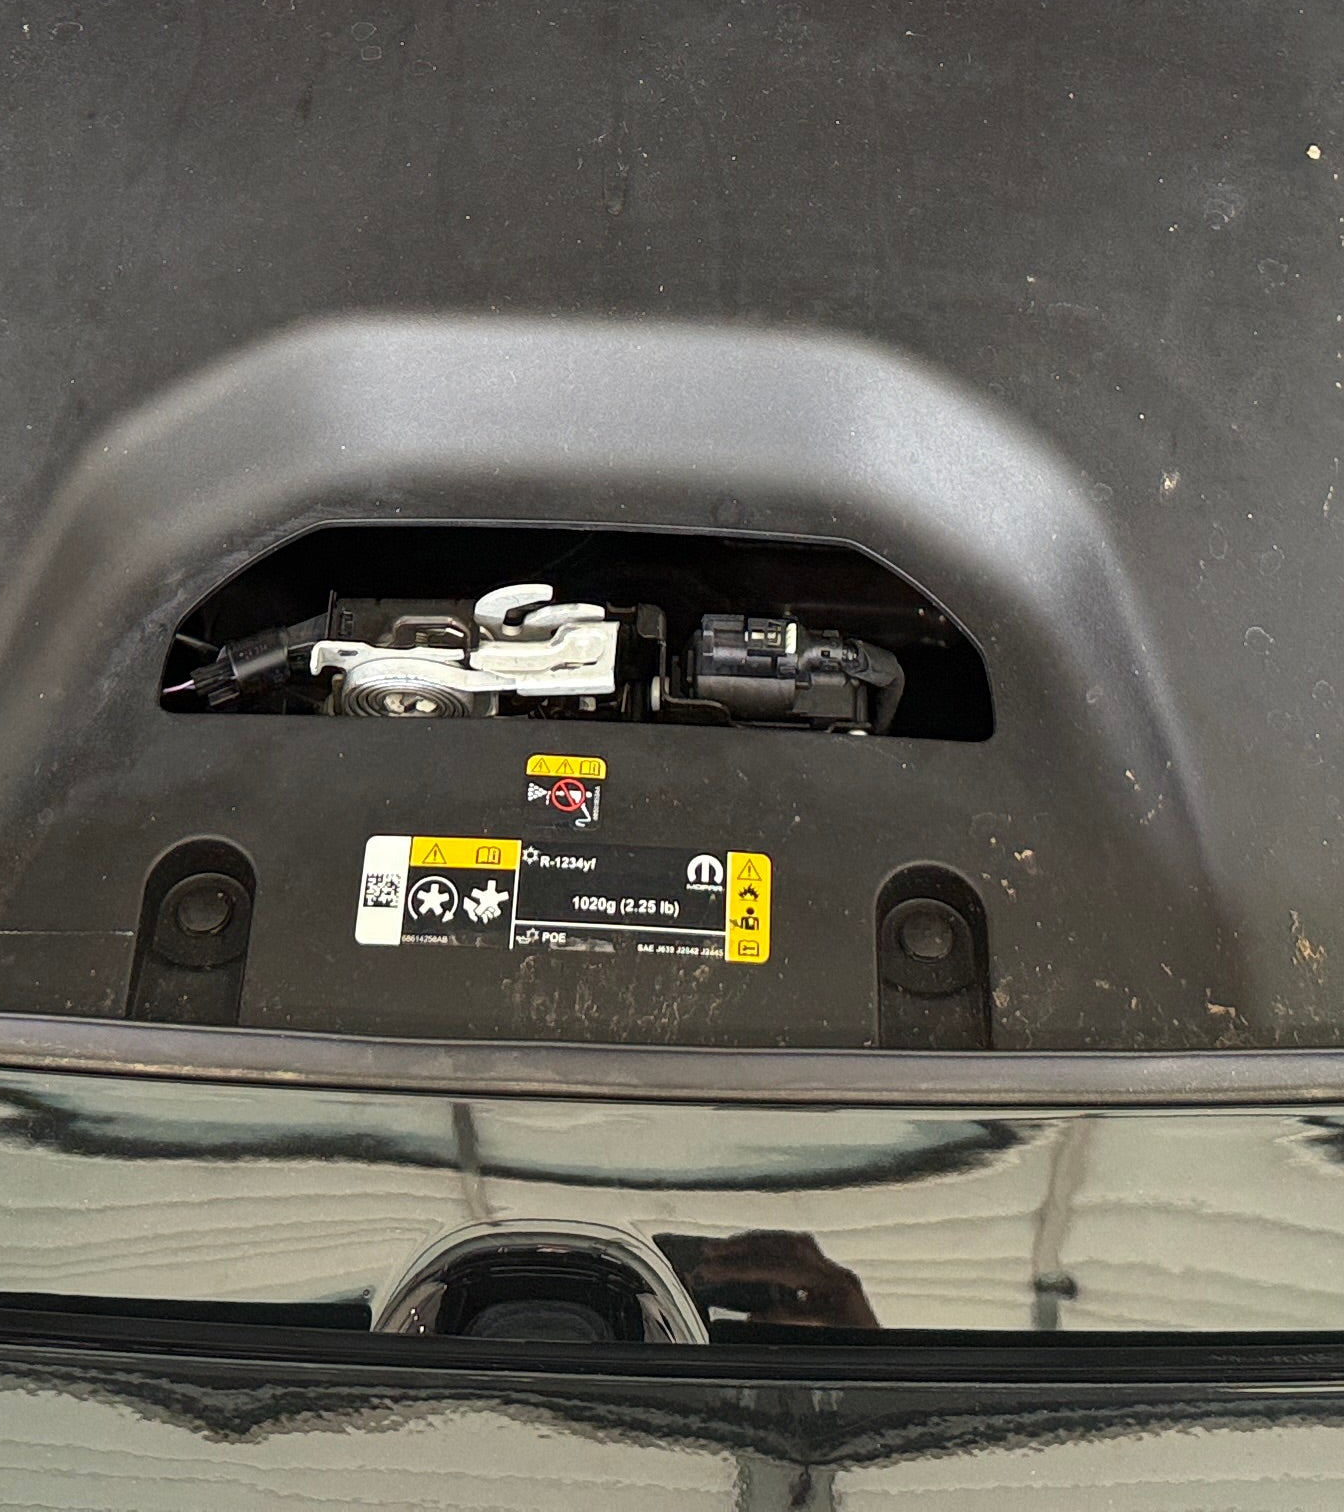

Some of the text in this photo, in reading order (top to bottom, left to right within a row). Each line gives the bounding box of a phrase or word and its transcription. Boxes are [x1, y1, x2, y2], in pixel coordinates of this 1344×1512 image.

[540, 855, 597, 872] R-1234yf
[572, 895, 680, 918] 1020g (2.25 lb)
[542, 931, 567, 943] POE
[637, 943, 655, 952] SAE
